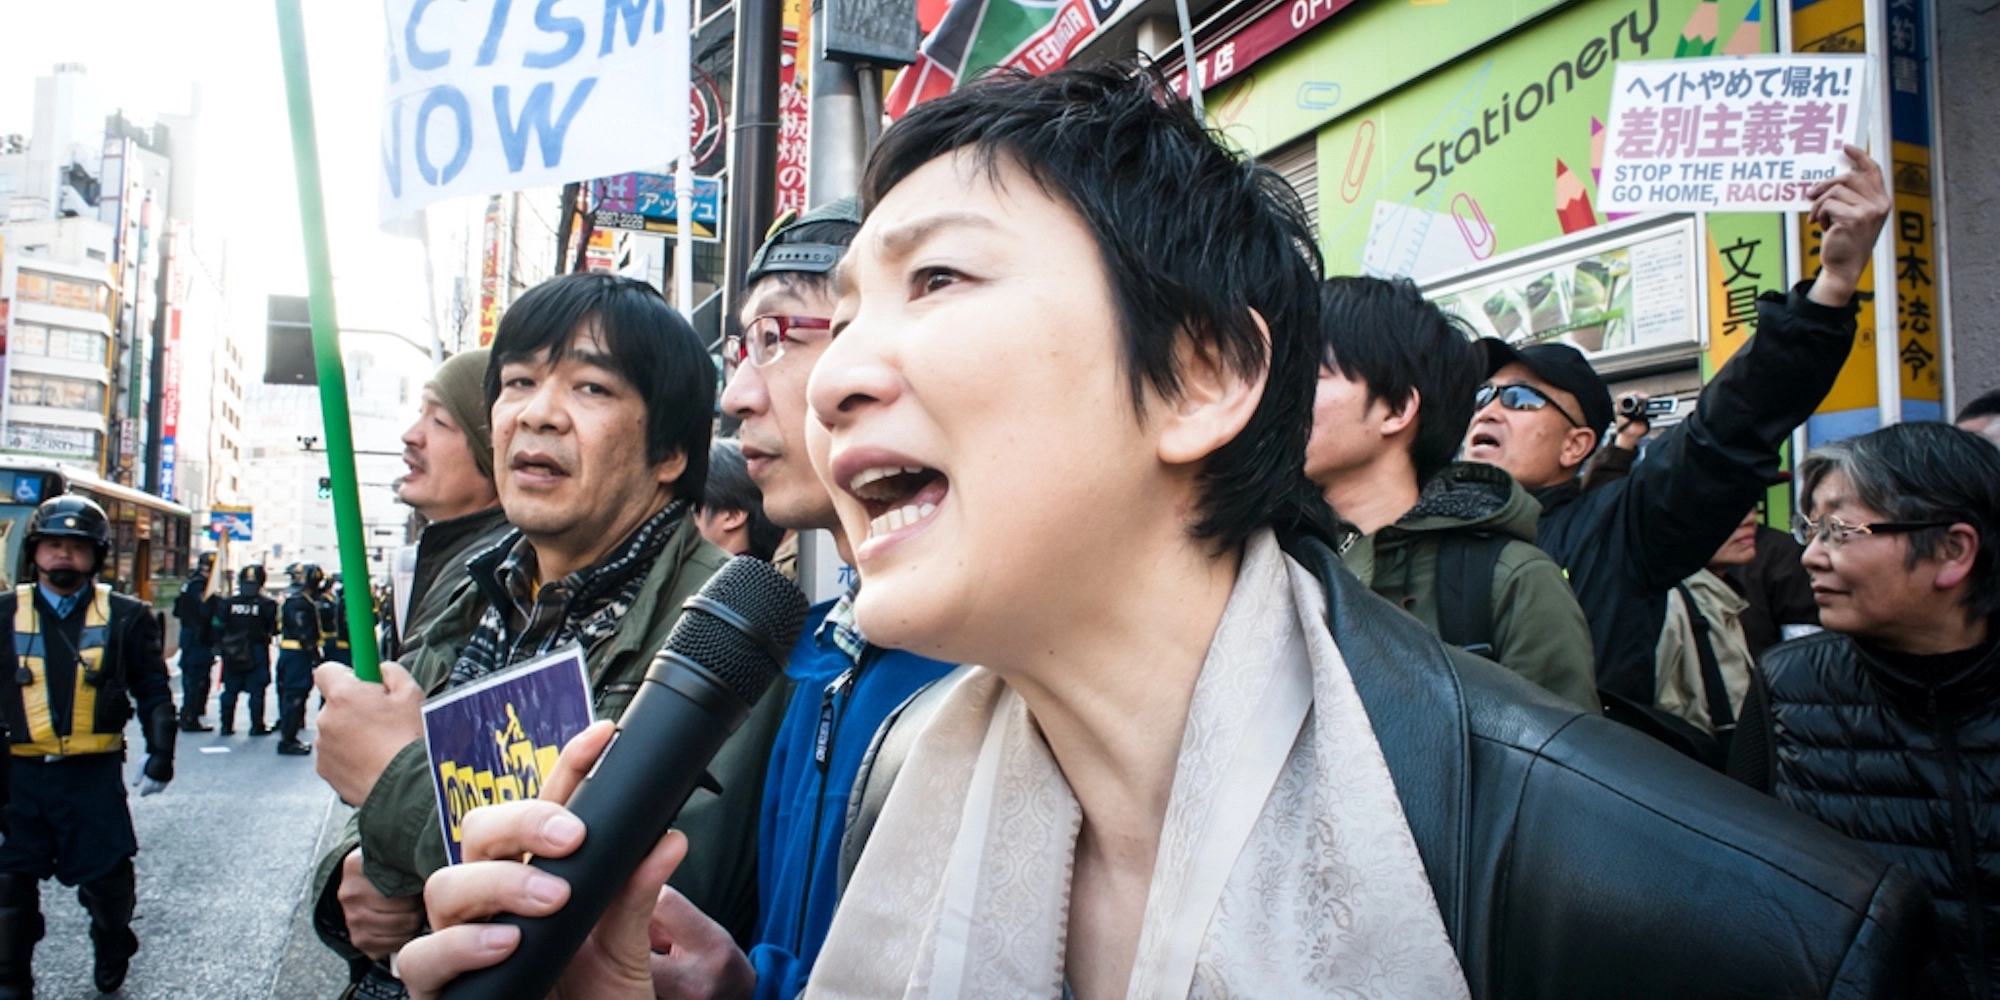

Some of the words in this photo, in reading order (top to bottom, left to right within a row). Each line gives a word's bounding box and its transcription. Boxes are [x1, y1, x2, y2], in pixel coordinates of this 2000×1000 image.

[1414, 0, 1659, 197] Stationery
[1626, 65, 1852, 102] ヘイトやめて帰れ!
[1614, 100, 1848, 159] 差別主義者!
[1612, 184, 1642, 202] GO
[1649, 184, 1719, 206] HOME,
[1614, 164, 1672, 182] STOP
[1679, 163, 1724, 180] THE
[1730, 161, 1795, 179] HATE
[1801, 166, 1836, 179] and
[1719, 237, 1762, 336] 文具
[1897, 211, 1934, 381] 日本法令
